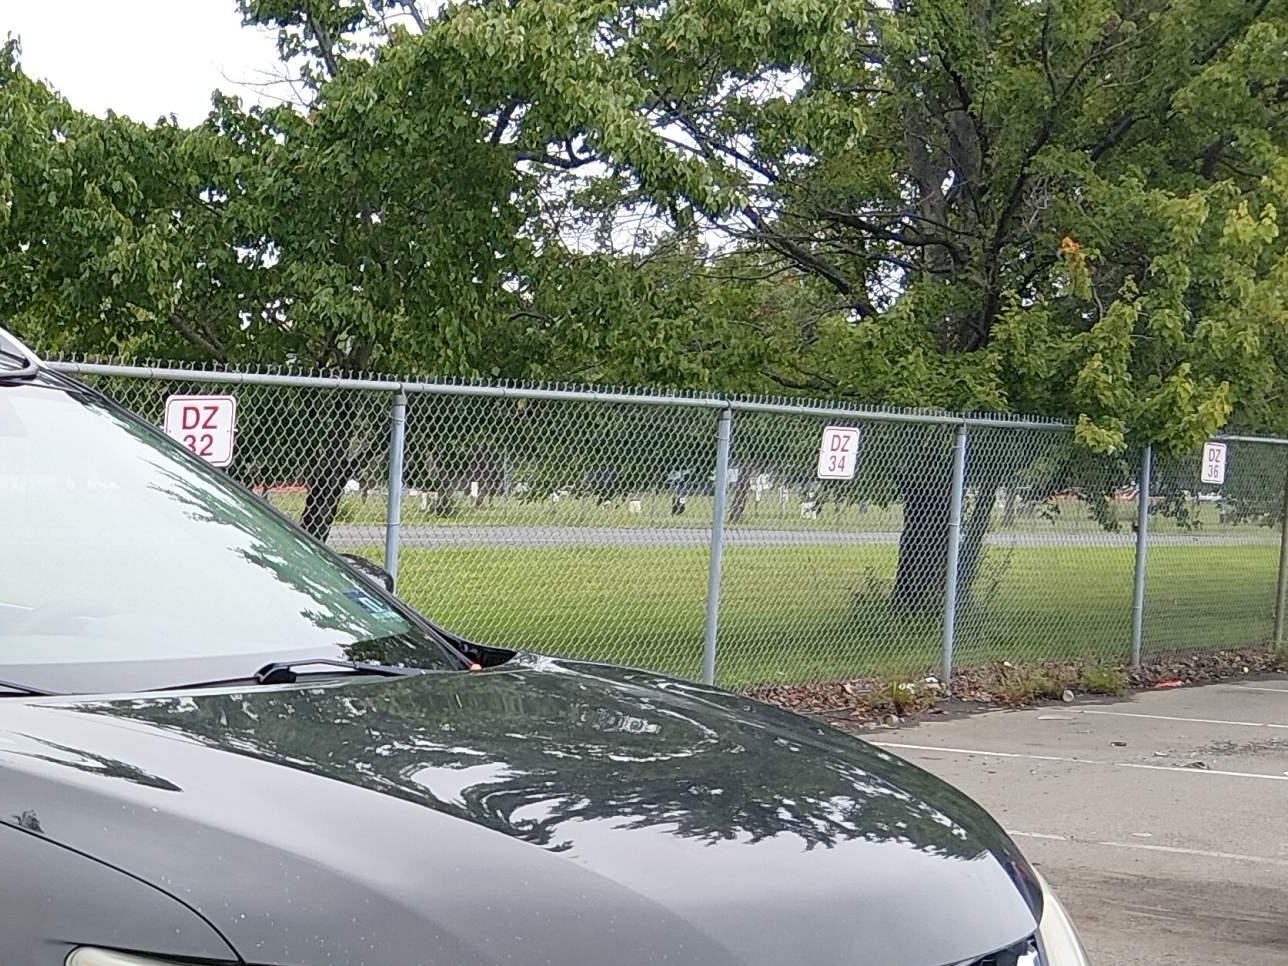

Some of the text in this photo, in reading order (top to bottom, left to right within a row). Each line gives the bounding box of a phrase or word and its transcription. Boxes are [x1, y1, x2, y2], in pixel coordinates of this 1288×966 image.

[182, 406, 219, 430] DZ
[183, 434, 214, 456] 32
[830, 434, 851, 452] DZ
[828, 455, 846, 473] 34
[1208, 448, 1221, 463] DZ
[1207, 464, 1219, 478] 36
